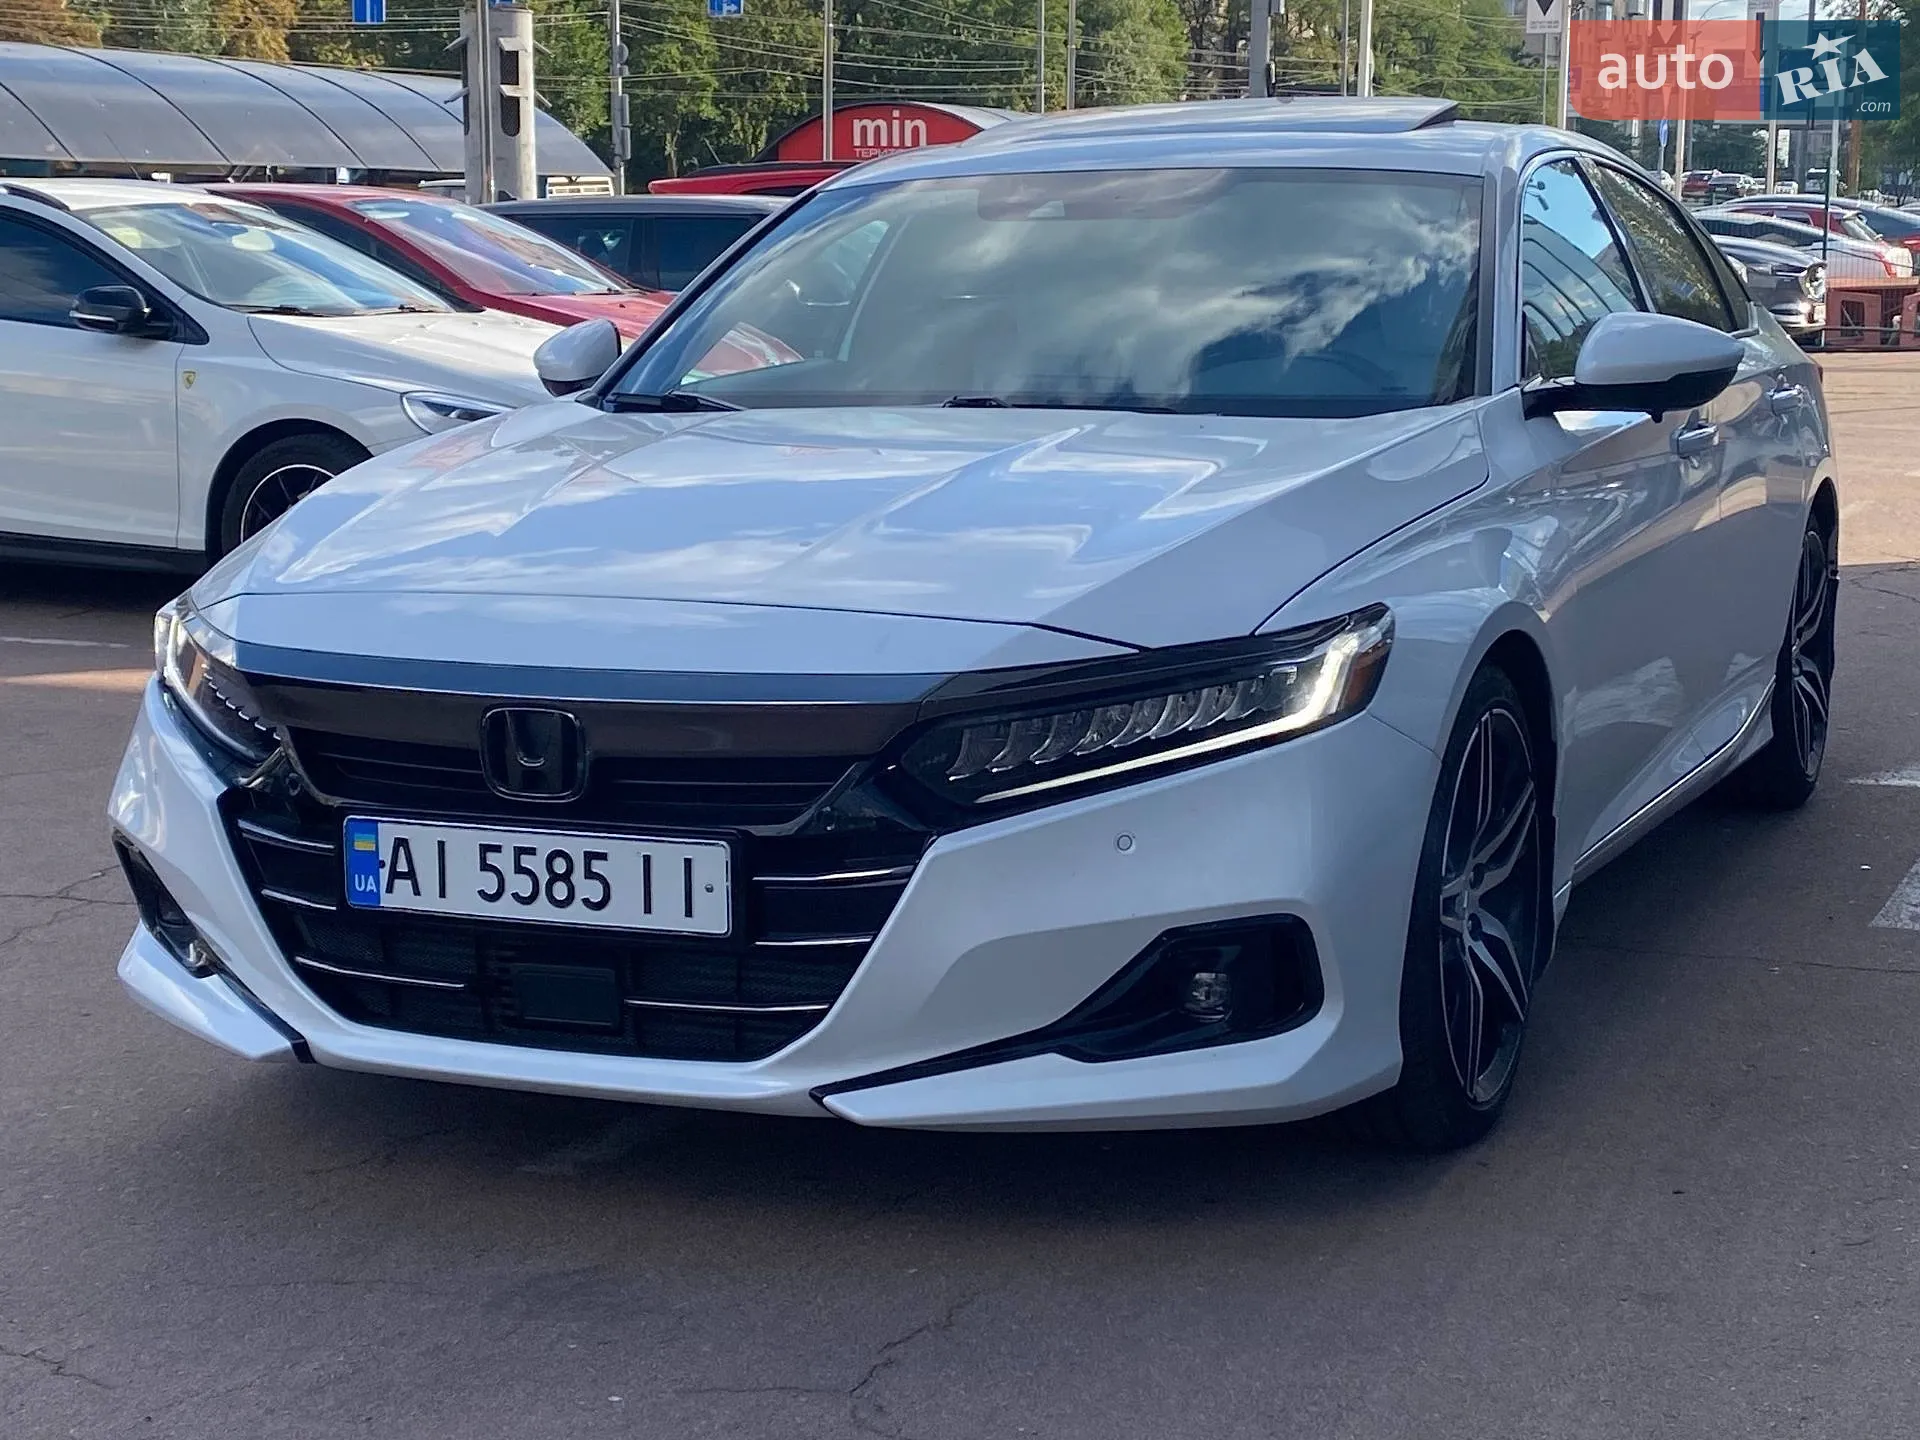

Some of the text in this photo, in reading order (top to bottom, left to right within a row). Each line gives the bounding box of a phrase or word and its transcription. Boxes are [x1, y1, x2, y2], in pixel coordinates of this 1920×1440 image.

[853, 109, 927, 147] min
[354, 873, 378, 893] UA
[385, 836, 693, 918] AI 5585 II
